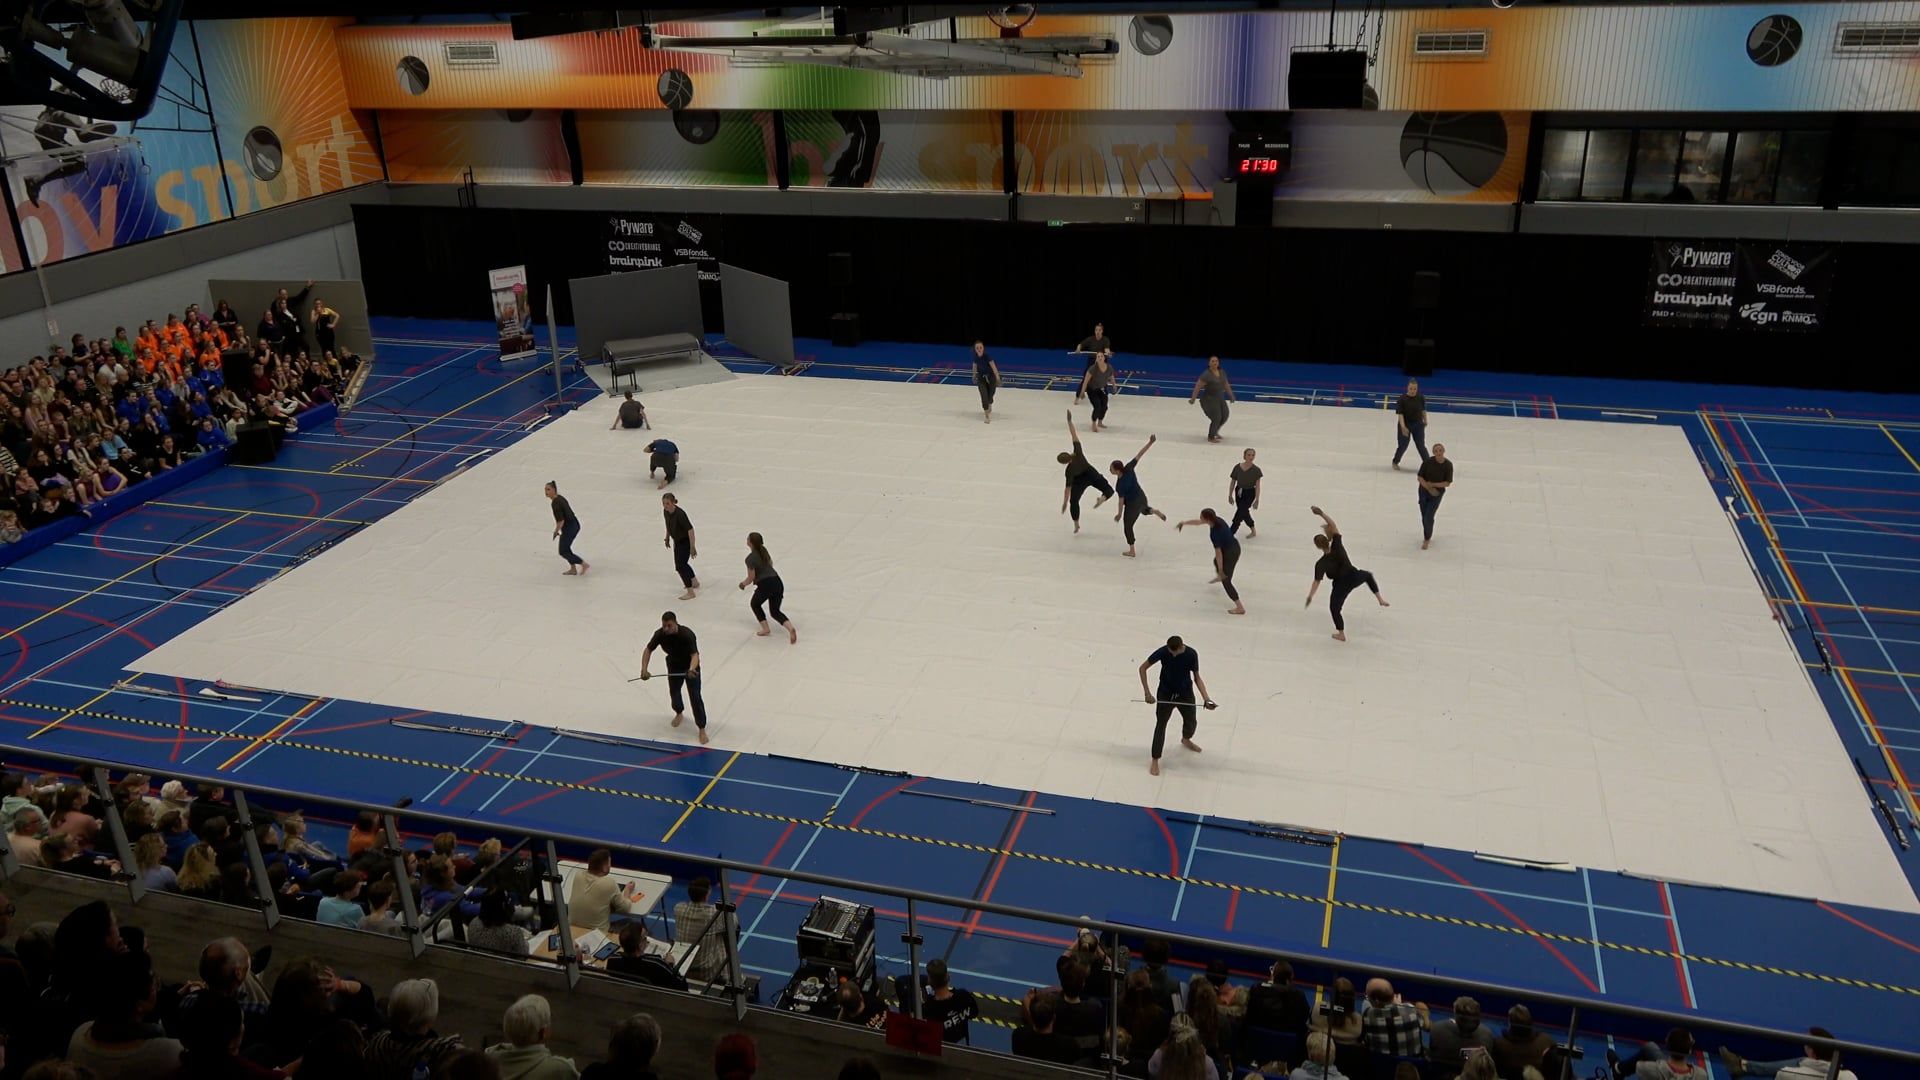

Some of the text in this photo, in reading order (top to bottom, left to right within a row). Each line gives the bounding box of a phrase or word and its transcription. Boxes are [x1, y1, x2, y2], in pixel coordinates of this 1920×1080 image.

[1241, 159, 1278, 171] 21:30
[620, 219, 654, 236] Pyware
[609, 254, 663, 268] brainpink
[1683, 247, 1732, 268] Pyware
[1653, 290, 1734, 307] brainpink
[1750, 311, 1779, 325] cgn
